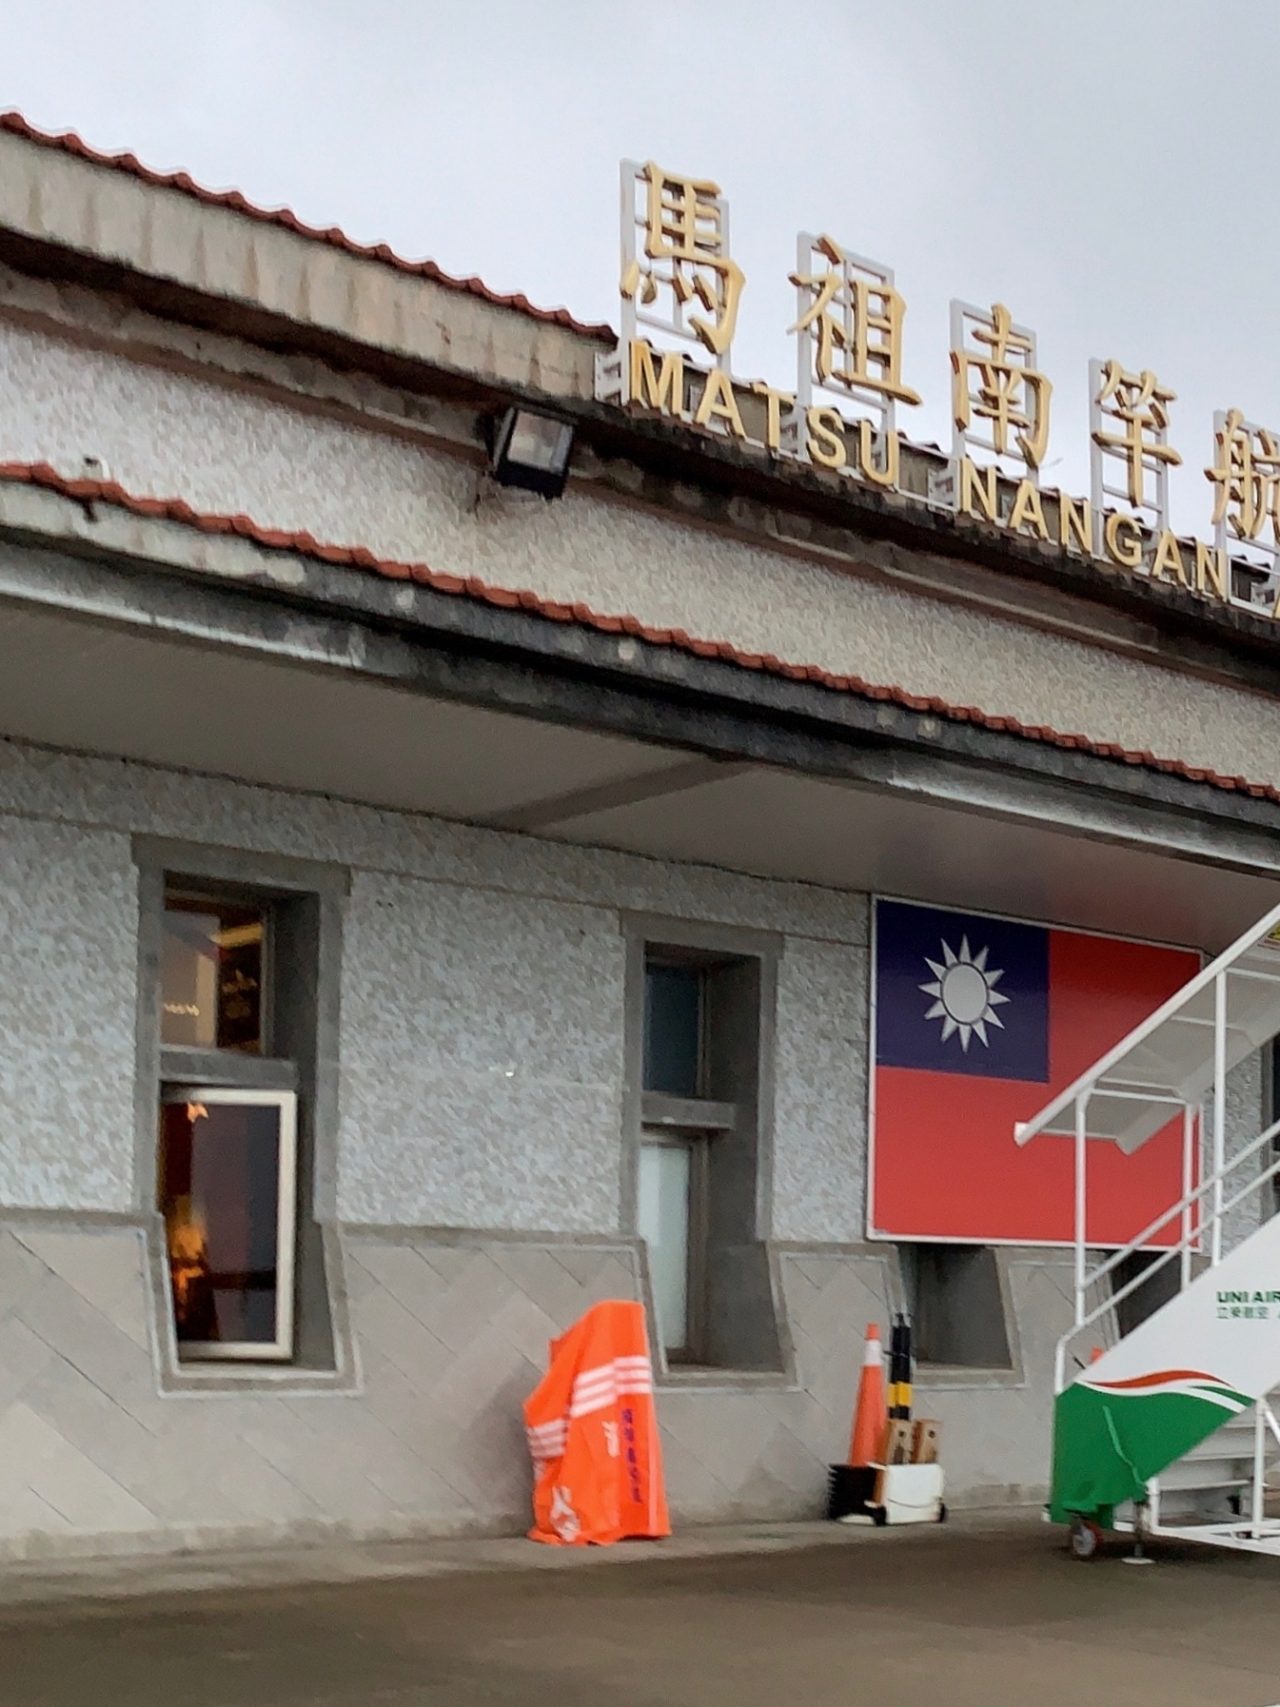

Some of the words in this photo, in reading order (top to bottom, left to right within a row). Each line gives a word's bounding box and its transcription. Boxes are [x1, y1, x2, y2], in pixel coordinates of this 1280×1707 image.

[629, 339, 898, 487] MATSU
[959, 457, 1226, 598] NANGAN
[1216, 1291, 1249, 1303] UNI
